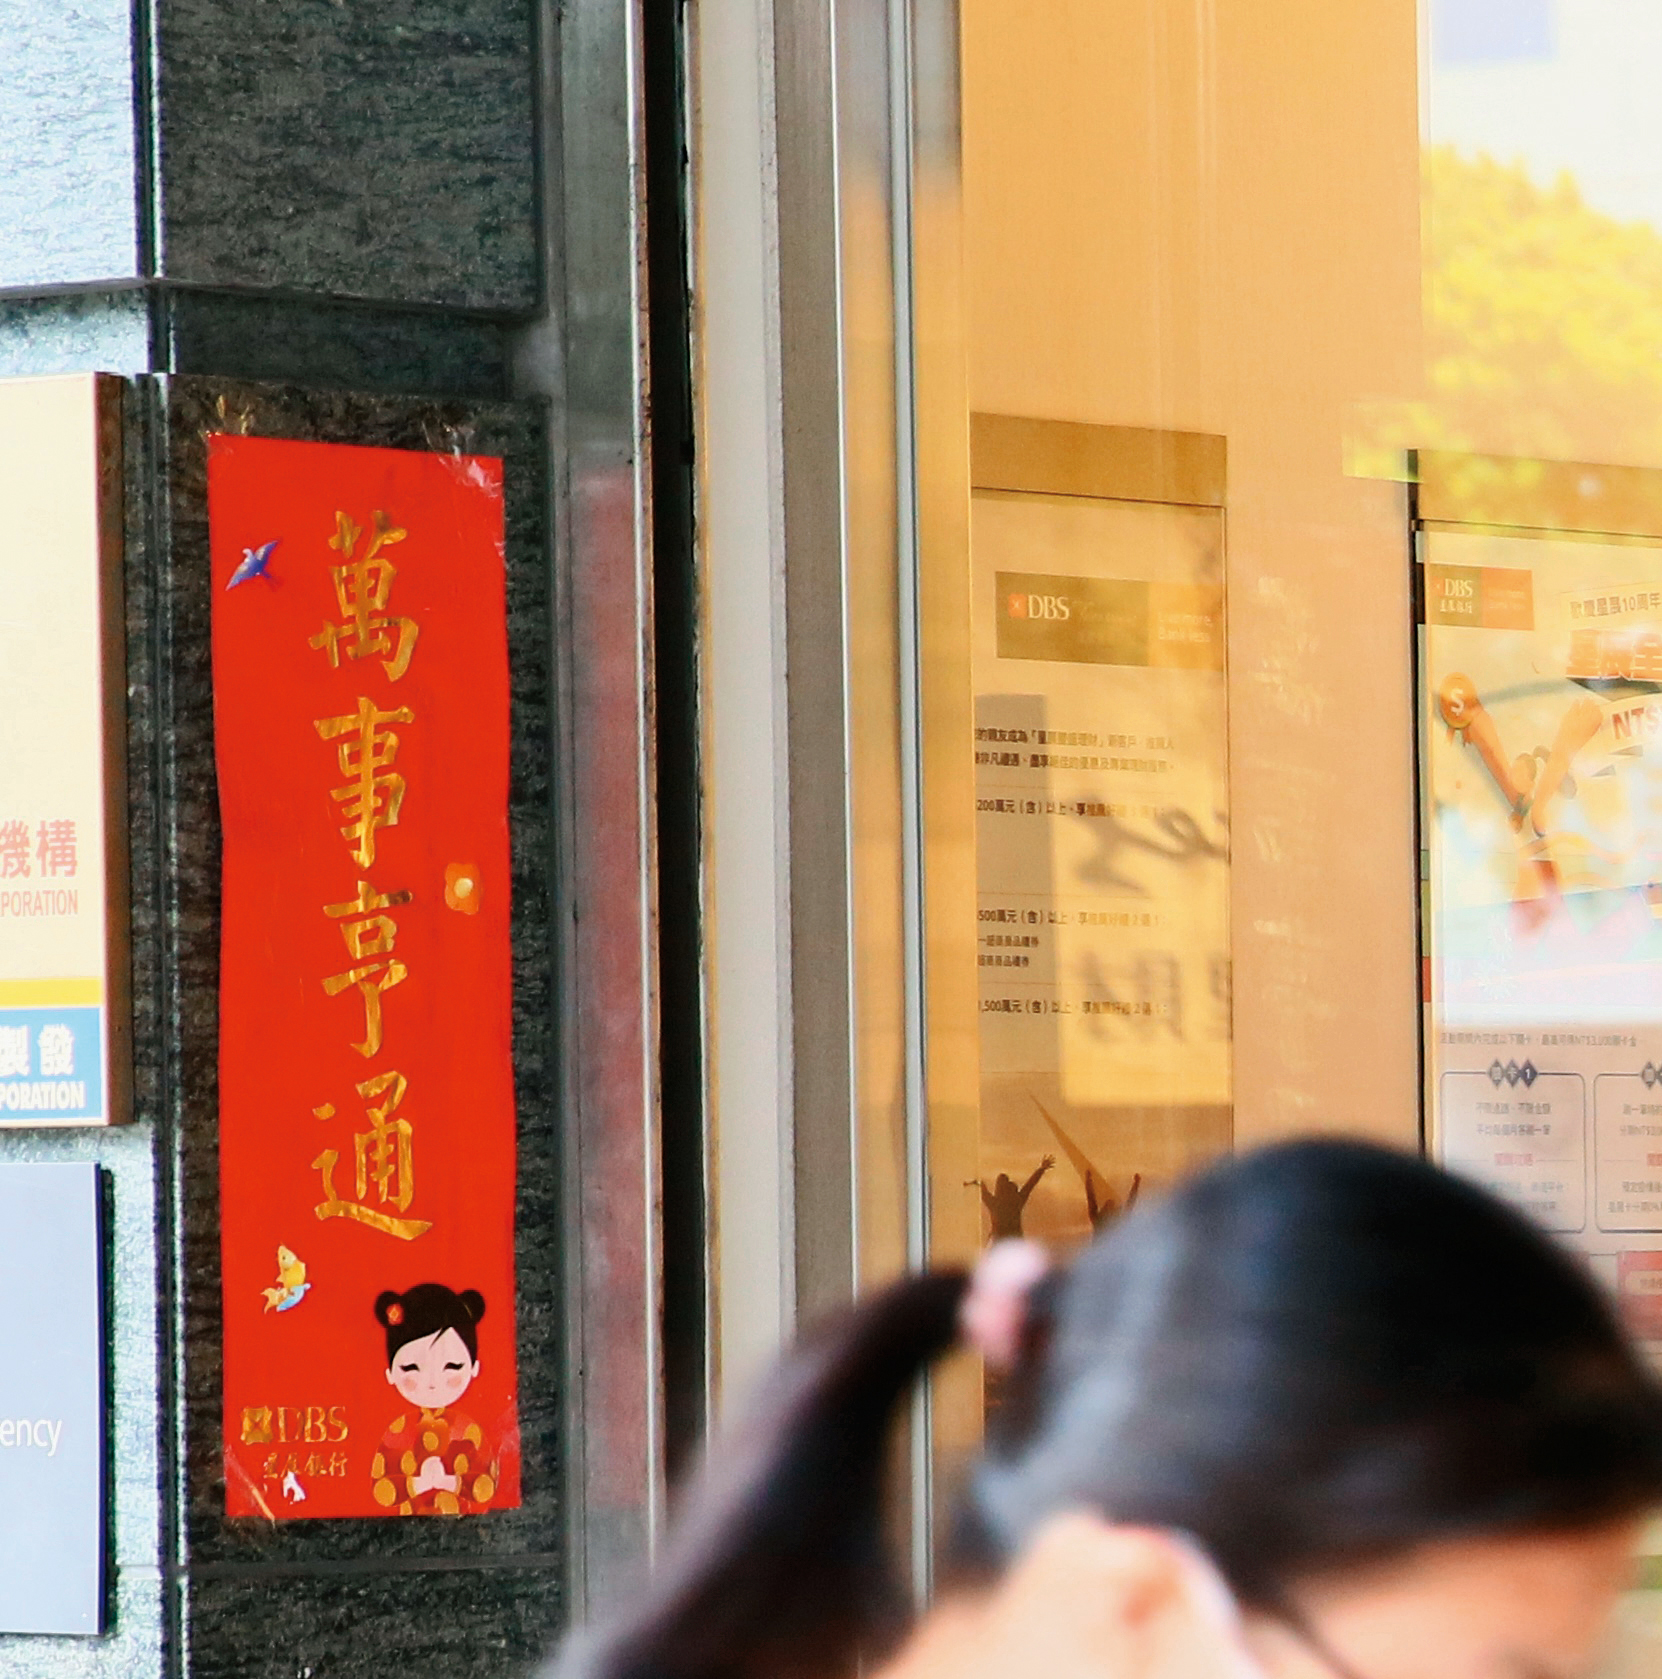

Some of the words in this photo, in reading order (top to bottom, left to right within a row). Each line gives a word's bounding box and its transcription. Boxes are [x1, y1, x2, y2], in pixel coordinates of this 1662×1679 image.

[1027, 594, 1071, 621] DBS
[309, 508, 432, 1243] 萬事亨通
[277, 1406, 348, 1443] DBS
